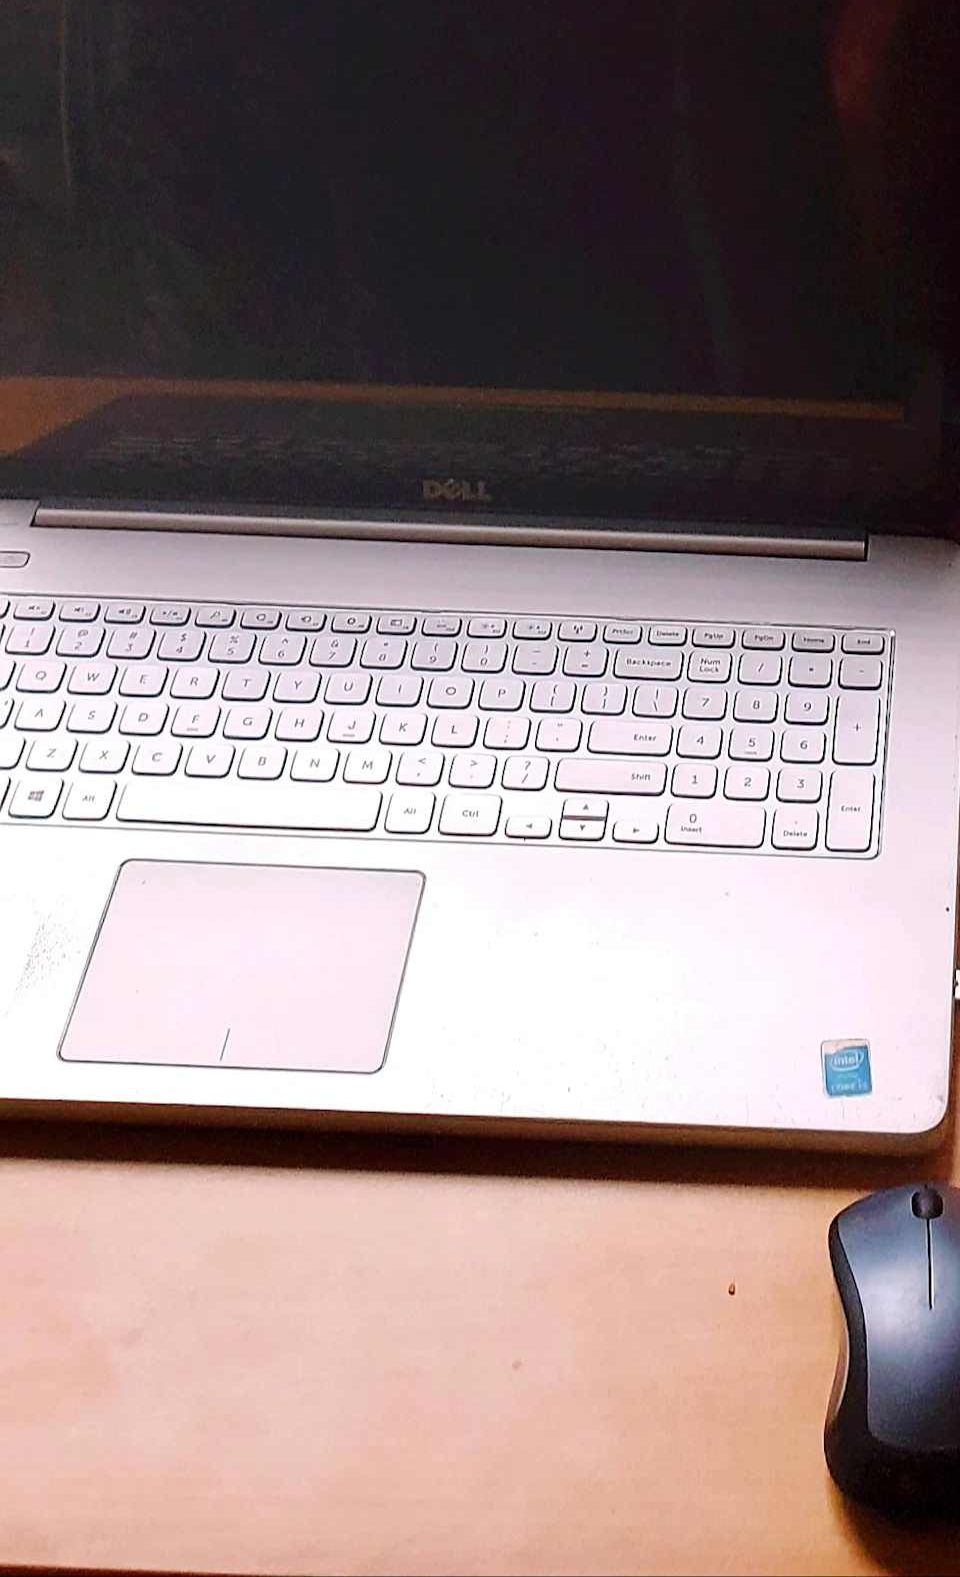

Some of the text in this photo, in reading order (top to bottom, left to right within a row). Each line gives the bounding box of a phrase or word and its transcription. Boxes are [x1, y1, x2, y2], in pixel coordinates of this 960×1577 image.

[422, 478, 491, 501] DELL
[626, 658, 671, 667] Backspace
[700, 657, 721, 665] Num
[699, 665, 720, 673] Lock
[633, 733, 657, 742] Enter
[631, 773, 651, 781] Shift
[461, 809, 479, 818] Ctrl
[833, 1049, 860, 1067] intel
